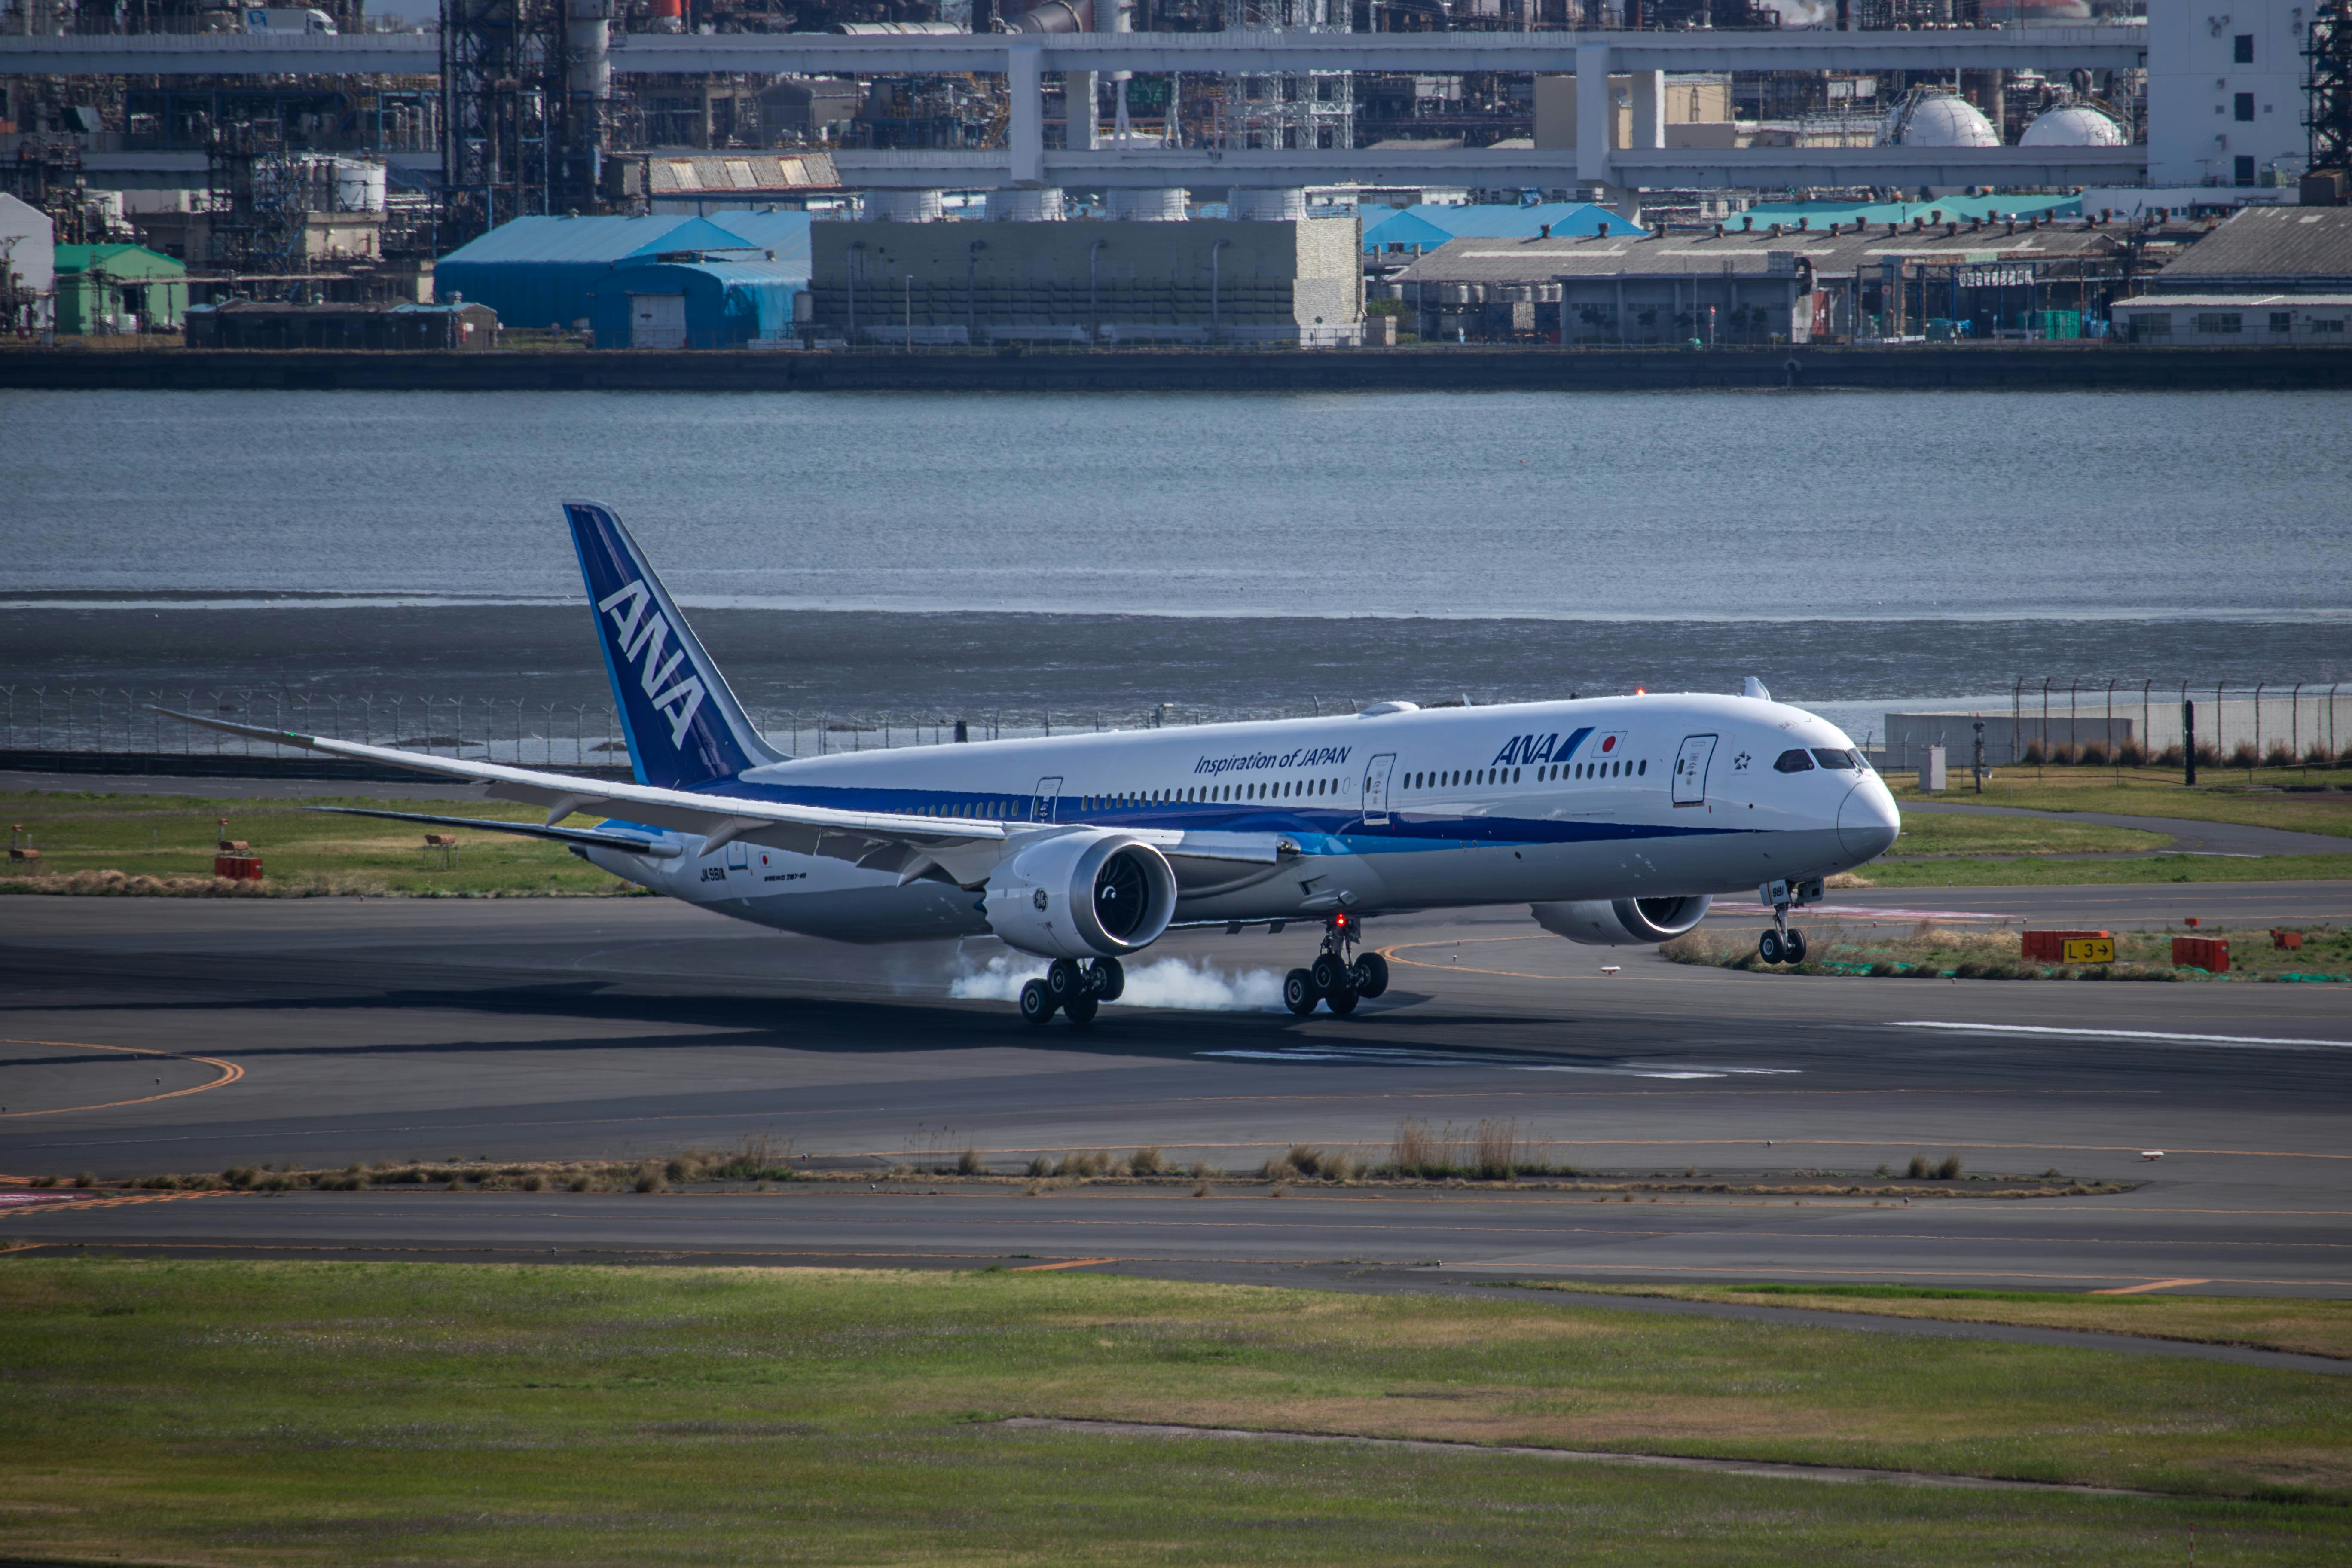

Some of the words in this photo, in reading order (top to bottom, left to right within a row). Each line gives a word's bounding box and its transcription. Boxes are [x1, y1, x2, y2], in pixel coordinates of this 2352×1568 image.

[598, 579, 708, 751] ANA
[1194, 752, 1277, 777] Inspiration
[1279, 748, 1303, 768] of
[1297, 746, 1353, 767] JAPAN
[1491, 733, 1559, 766] ANA
